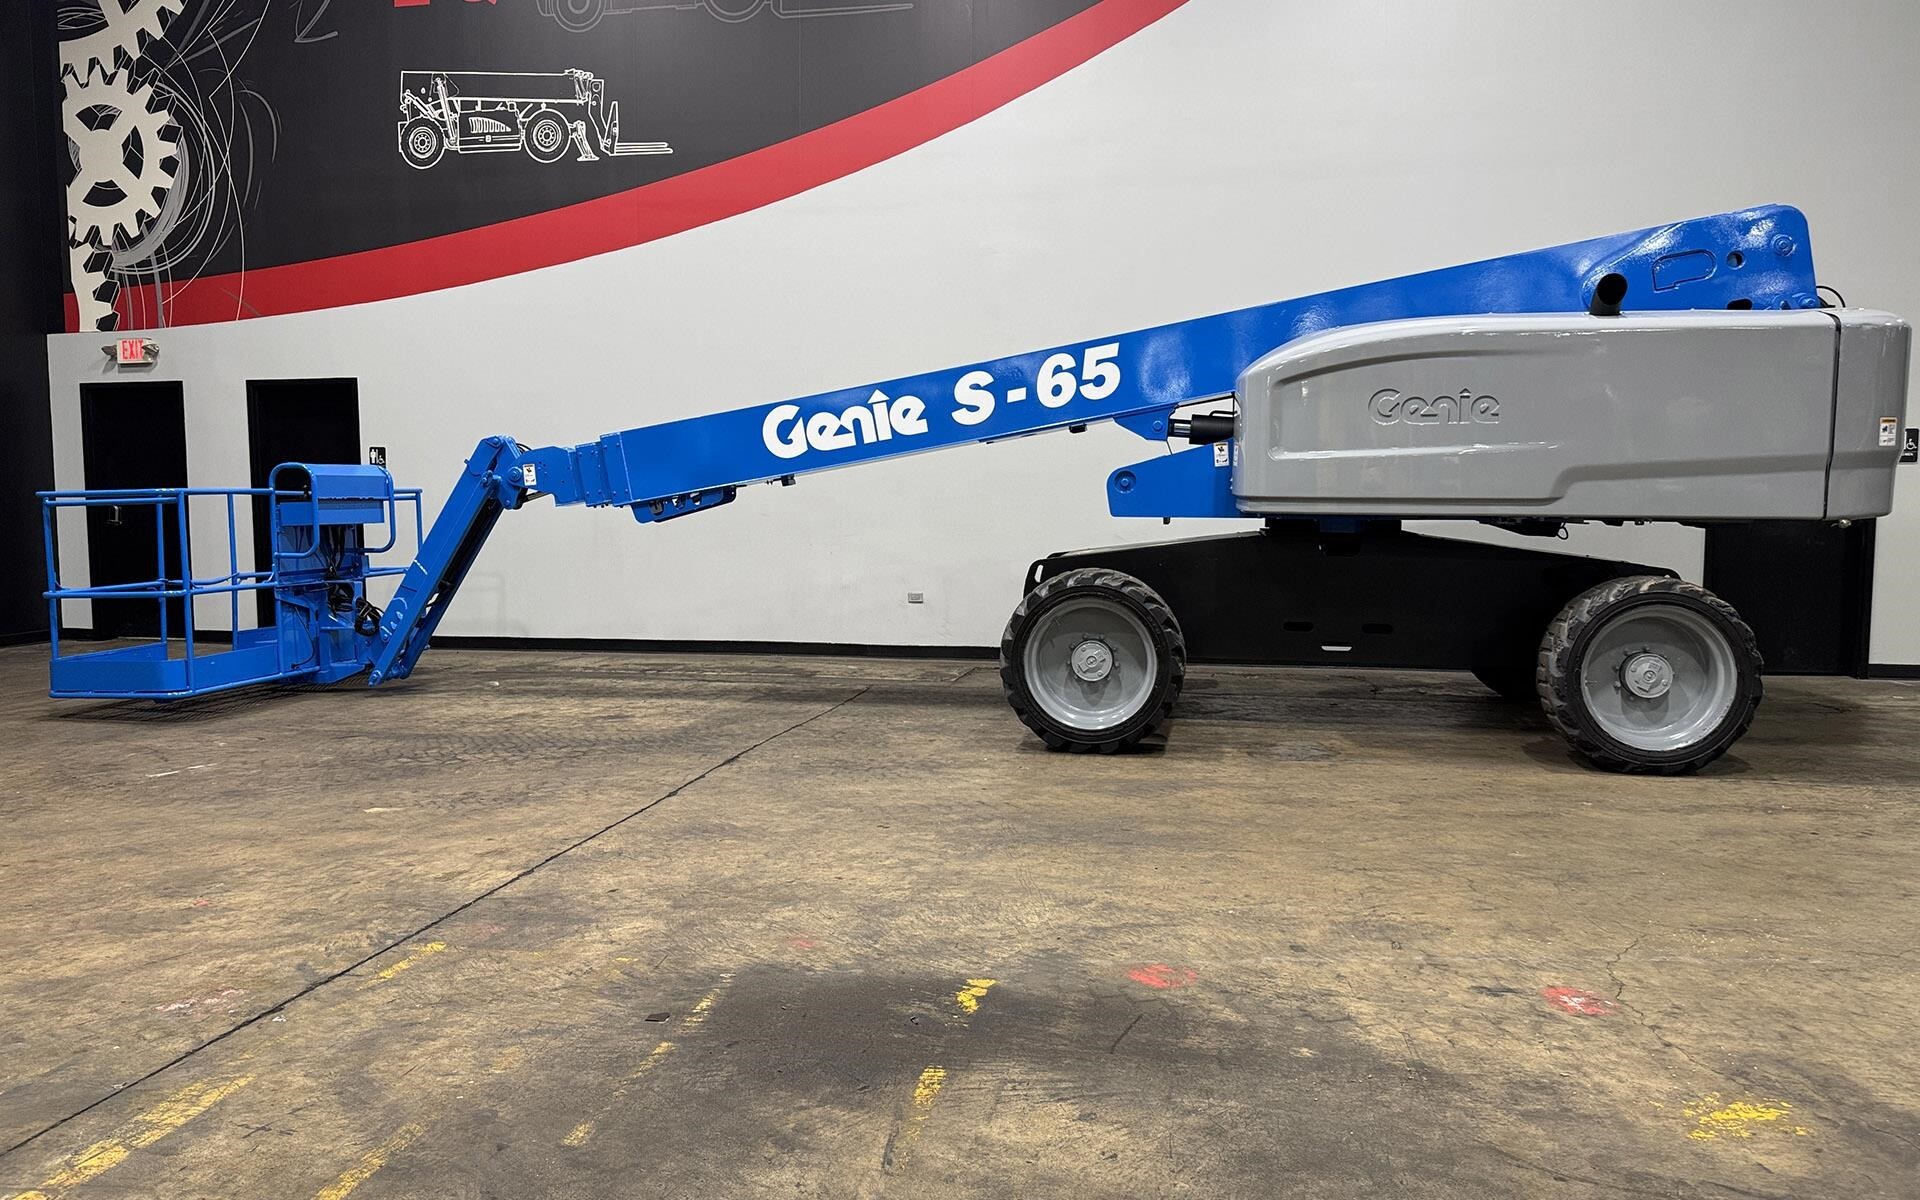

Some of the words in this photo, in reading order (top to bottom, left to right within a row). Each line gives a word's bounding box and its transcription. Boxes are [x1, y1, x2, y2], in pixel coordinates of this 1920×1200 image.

[121, 340, 144, 360] EXIT
[762, 389, 929, 459] Genie
[1368, 387, 1500, 425] Genie
